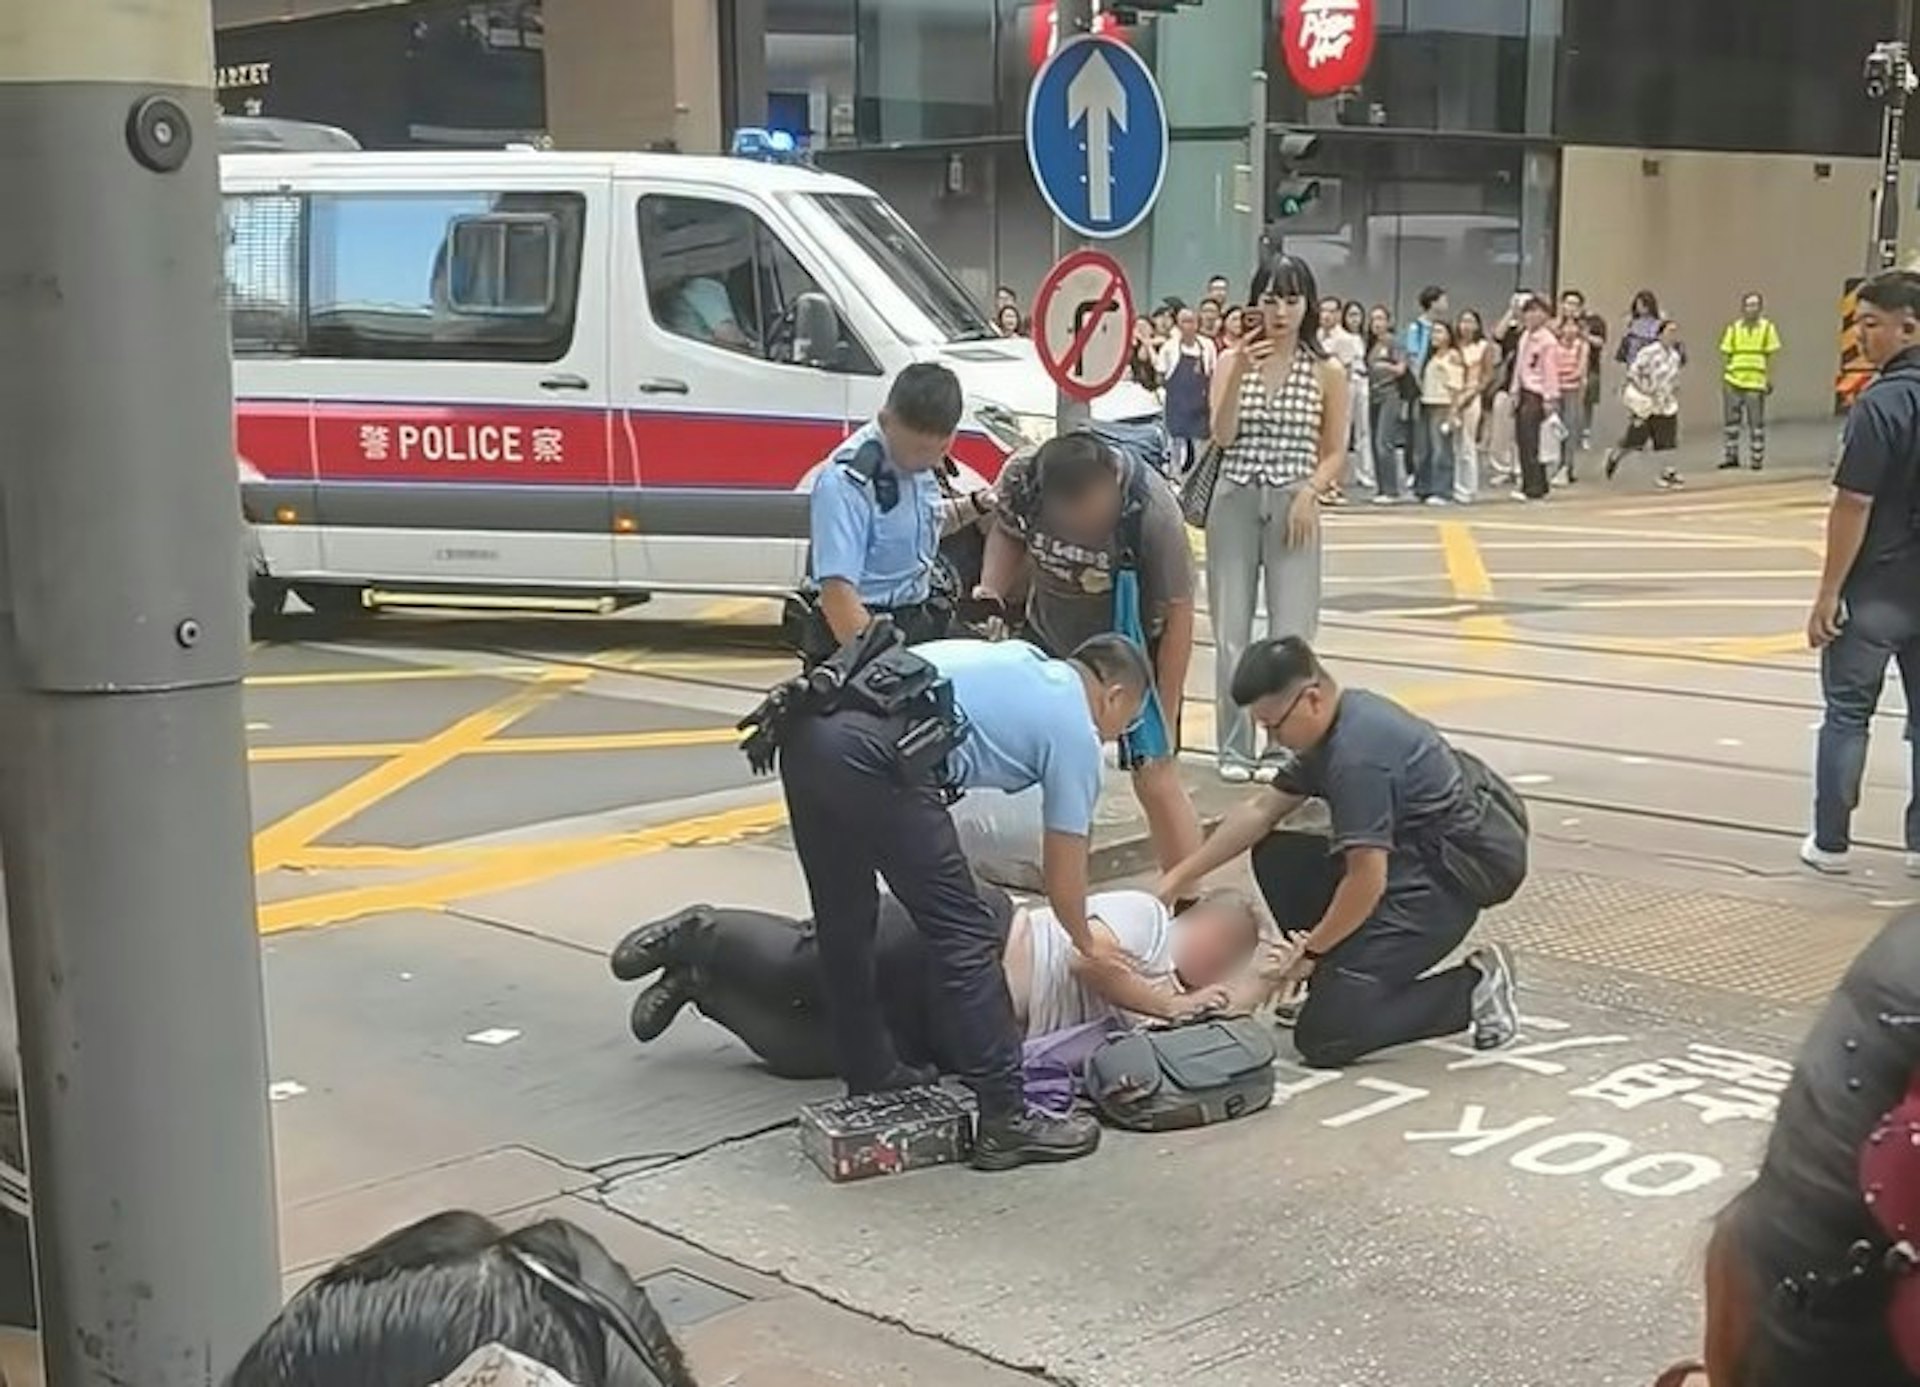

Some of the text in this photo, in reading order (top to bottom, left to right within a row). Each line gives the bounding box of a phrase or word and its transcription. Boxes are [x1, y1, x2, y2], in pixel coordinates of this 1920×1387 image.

[217, 62, 271, 88] ARKET
[360, 425, 563, 462] 警 POLICE 察
[1404, 1105, 1723, 1196] OOK
